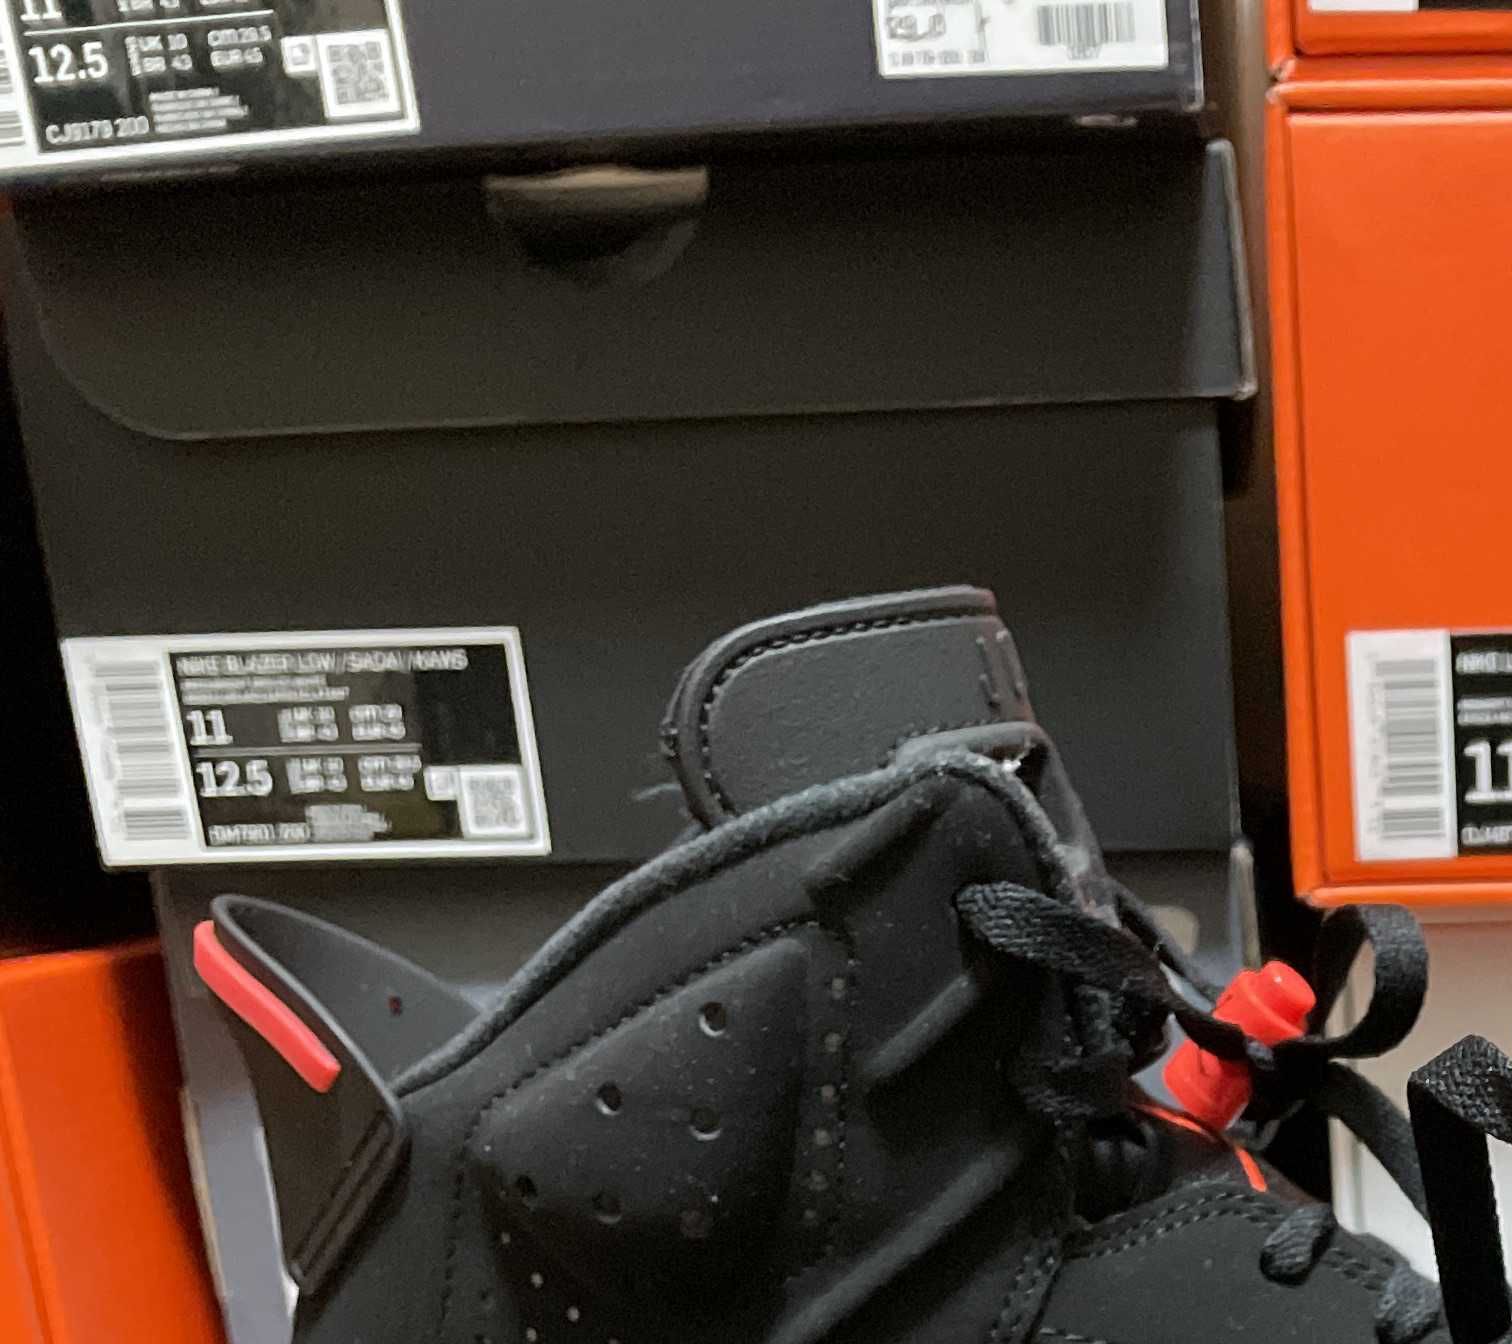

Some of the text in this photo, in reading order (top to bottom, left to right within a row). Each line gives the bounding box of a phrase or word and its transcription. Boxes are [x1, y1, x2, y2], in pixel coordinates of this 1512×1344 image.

[29, 41, 109, 84] 12.5
[186, 708, 234, 745] 11
[196, 758, 274, 798] 12.5
